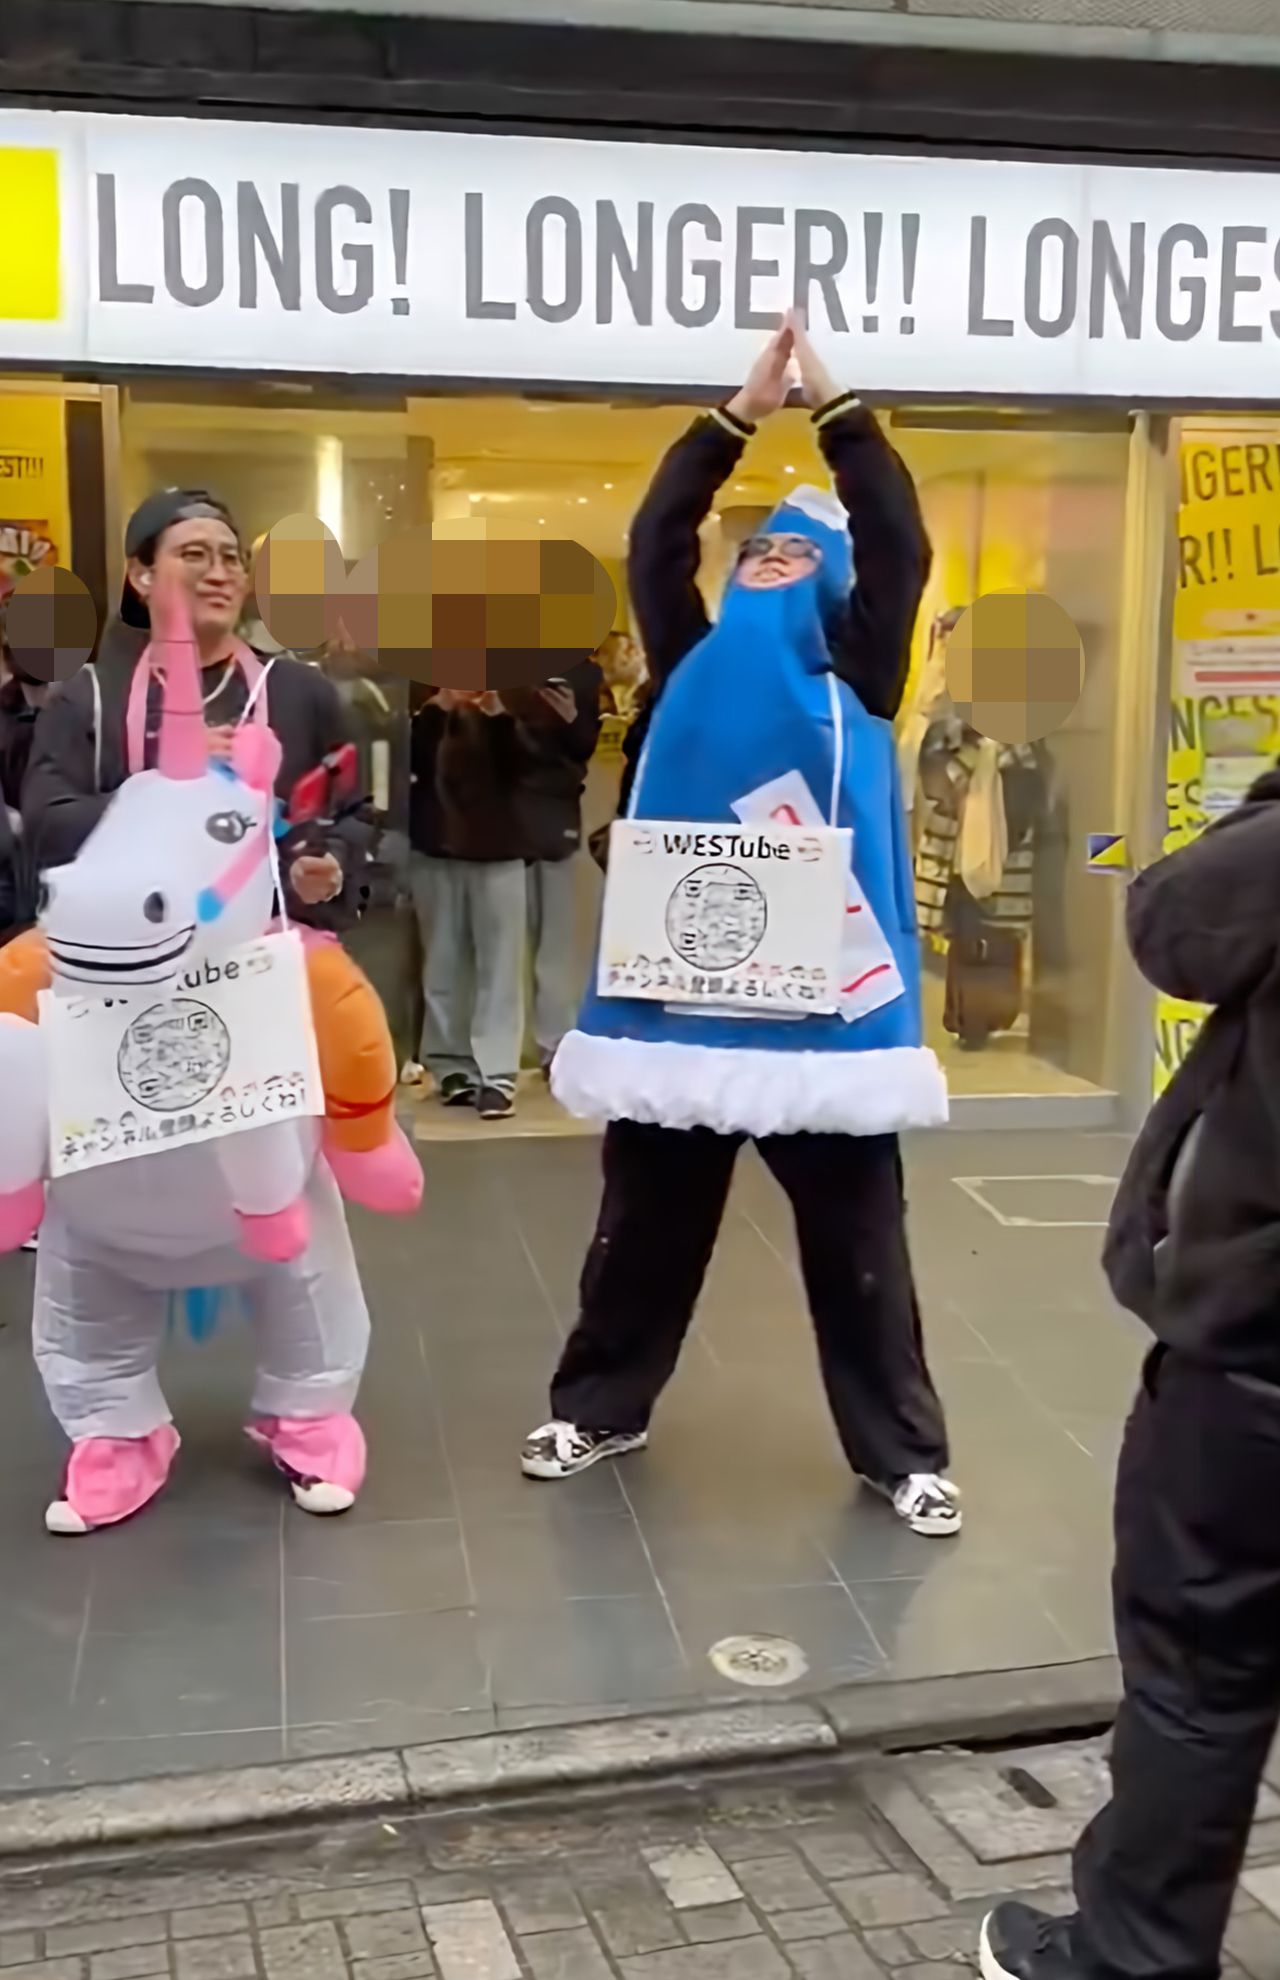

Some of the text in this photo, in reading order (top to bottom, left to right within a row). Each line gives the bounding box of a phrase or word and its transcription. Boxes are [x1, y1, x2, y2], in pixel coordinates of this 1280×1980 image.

[97, 173, 1280, 342] LONG! LONGER!! LONGE
[1254, 524, 1280, 576] L
[664, 833, 791, 860] WESTube
